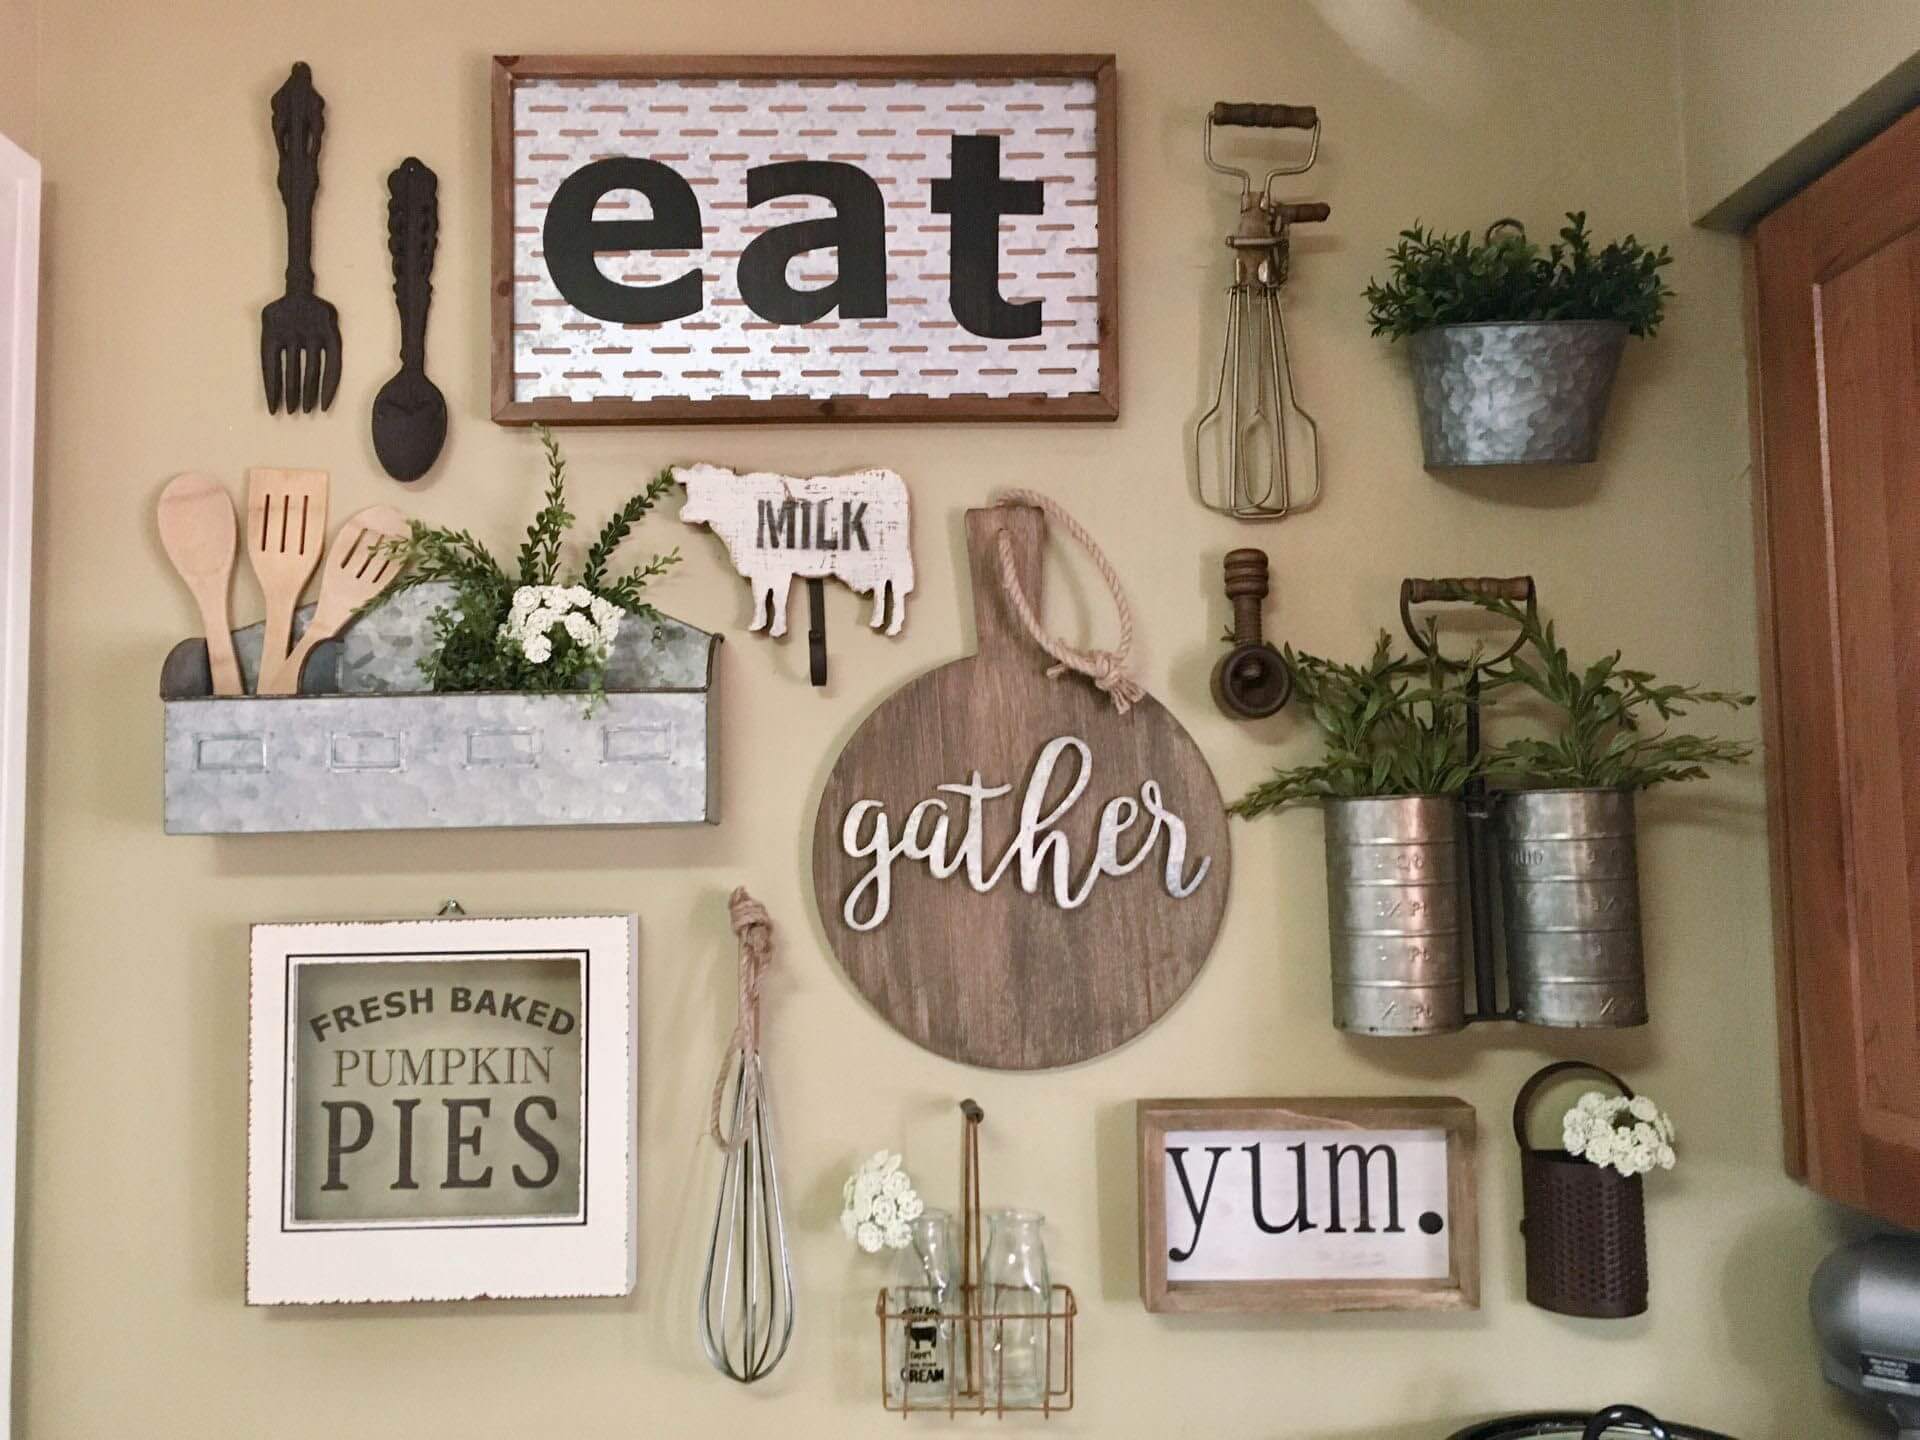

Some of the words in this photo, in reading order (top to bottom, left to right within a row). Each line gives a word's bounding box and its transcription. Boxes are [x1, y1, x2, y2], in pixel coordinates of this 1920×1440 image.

[542, 134, 1044, 339] eat
[755, 497, 870, 552] MILK
[841, 734, 1213, 934] gather
[309, 986, 434, 1042] FRESH
[450, 985, 577, 1037] BAKED
[331, 1046, 555, 1087] PUMPKIN
[319, 1094, 561, 1193] PIES
[1165, 1142, 1446, 1263] yum.
[901, 1368, 944, 1384] CREAM
